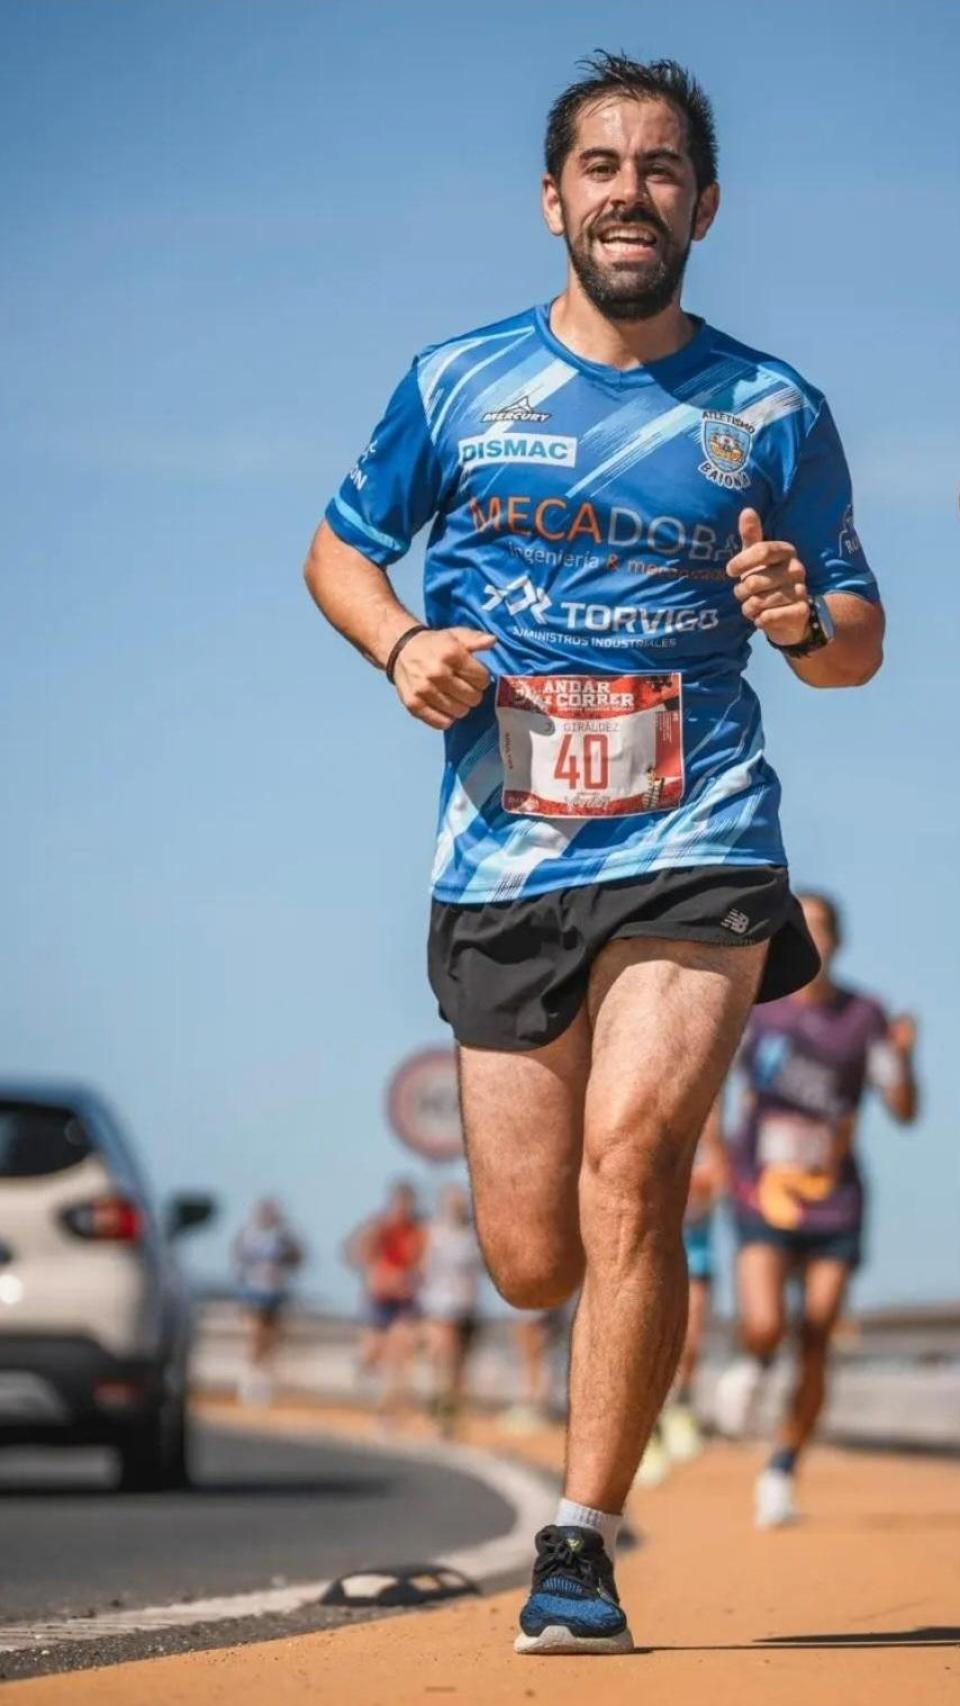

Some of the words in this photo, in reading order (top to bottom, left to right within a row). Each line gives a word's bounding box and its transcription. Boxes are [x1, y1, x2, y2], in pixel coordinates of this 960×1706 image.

[481, 411, 552, 422] MERCURY
[702, 410, 755, 434] ATLETISMO
[461, 440, 568, 463] DISMAC
[607, 553, 618, 570] &
[560, 602, 719, 634] TORVIGO
[543, 680, 610, 694] ANDAR
[557, 693, 634, 707] CORRER
[553, 733, 609, 790] 40
